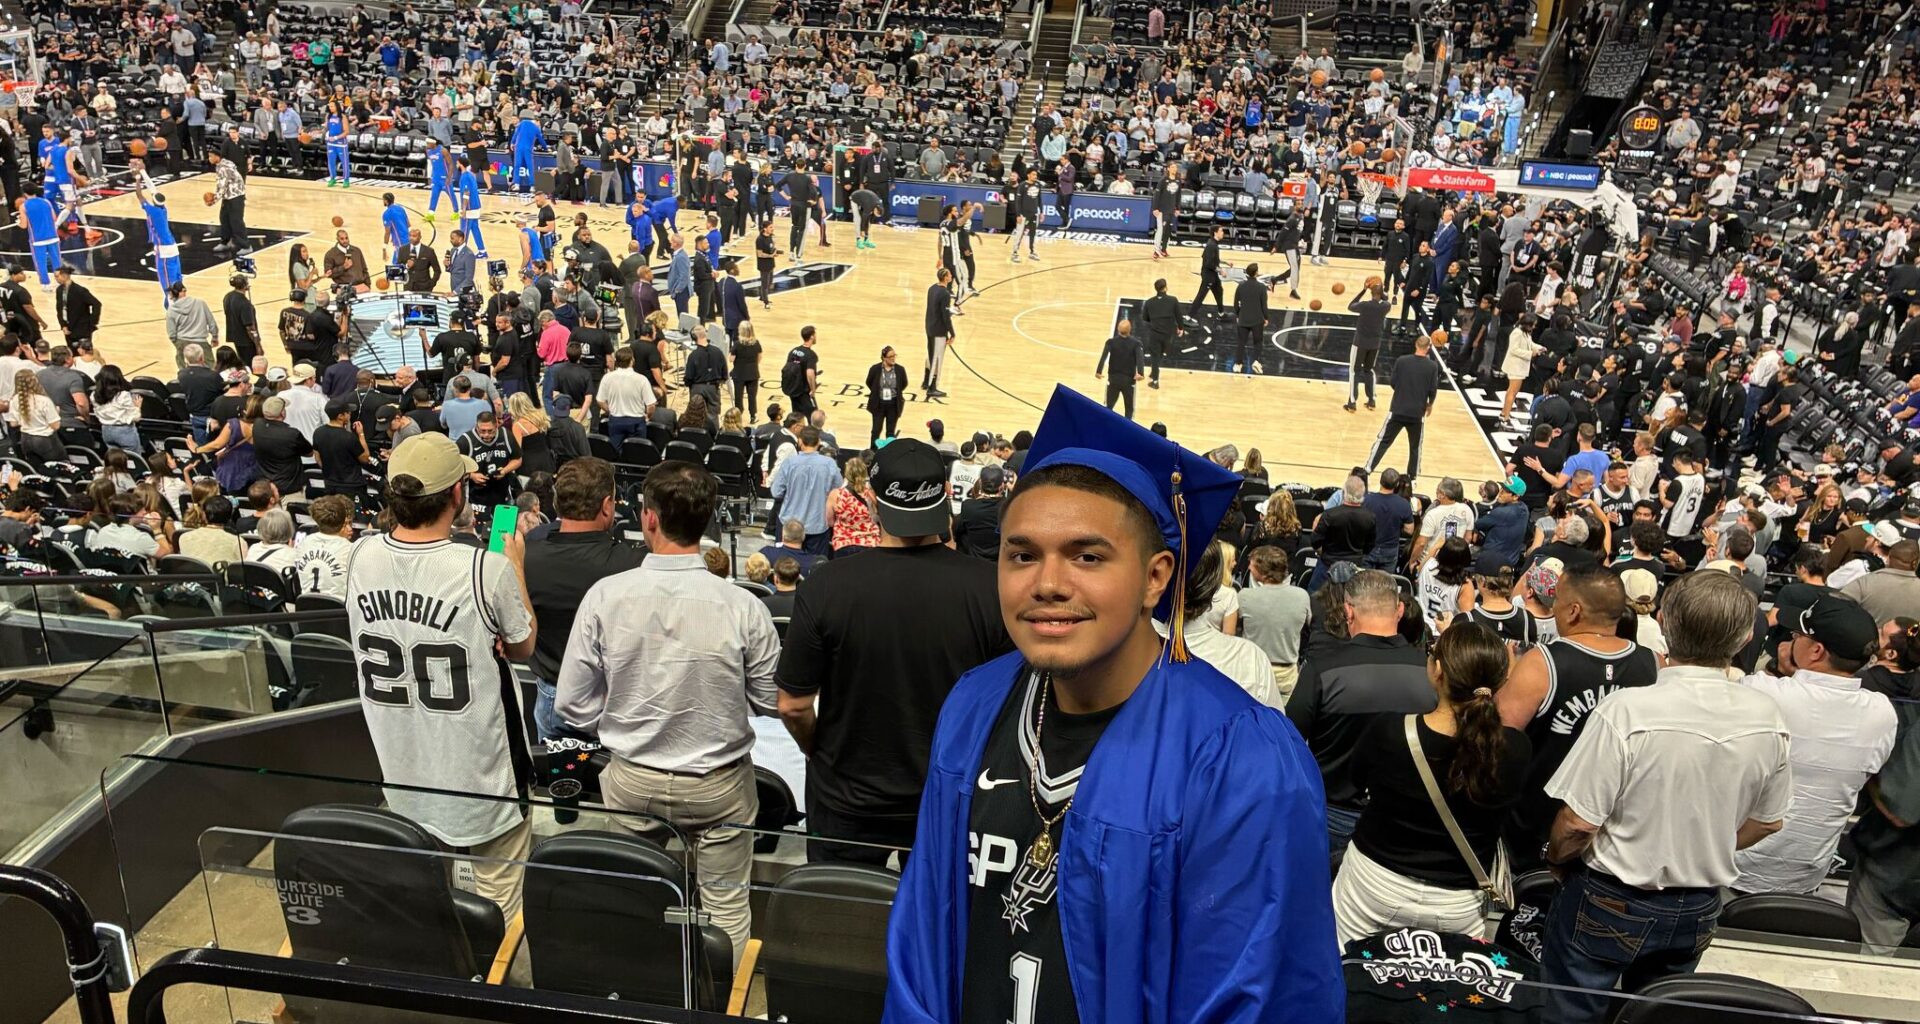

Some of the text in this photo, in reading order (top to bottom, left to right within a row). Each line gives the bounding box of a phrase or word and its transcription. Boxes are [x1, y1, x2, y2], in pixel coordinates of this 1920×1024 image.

[1634, 118, 1658, 130] 8:09
[1291, 184, 1301, 193] G
[1441, 174, 1487, 186] StateFarm
[1074, 208, 1124, 220] peacock
[1584, 254, 1598, 265] GET
[476, 450, 506, 462] SPURS
[487, 463, 496, 474] 2
[1687, 498, 1696, 513] 3
[295, 550, 342, 577] WEMBANYAMA
[310, 567, 320, 593] 1
[1424, 584, 1448, 602] CASTLE
[358, 590, 459, 632] GINOBILI
[1427, 599, 1441, 619] 5
[357, 630, 472, 714] 20
[255, 879, 344, 898] COURTSIDE
[279, 890, 324, 909] SUITE
[287, 906, 321, 925] 3
[1384, 928, 1446, 960] Up
[1006, 950, 1042, 1024] 1
